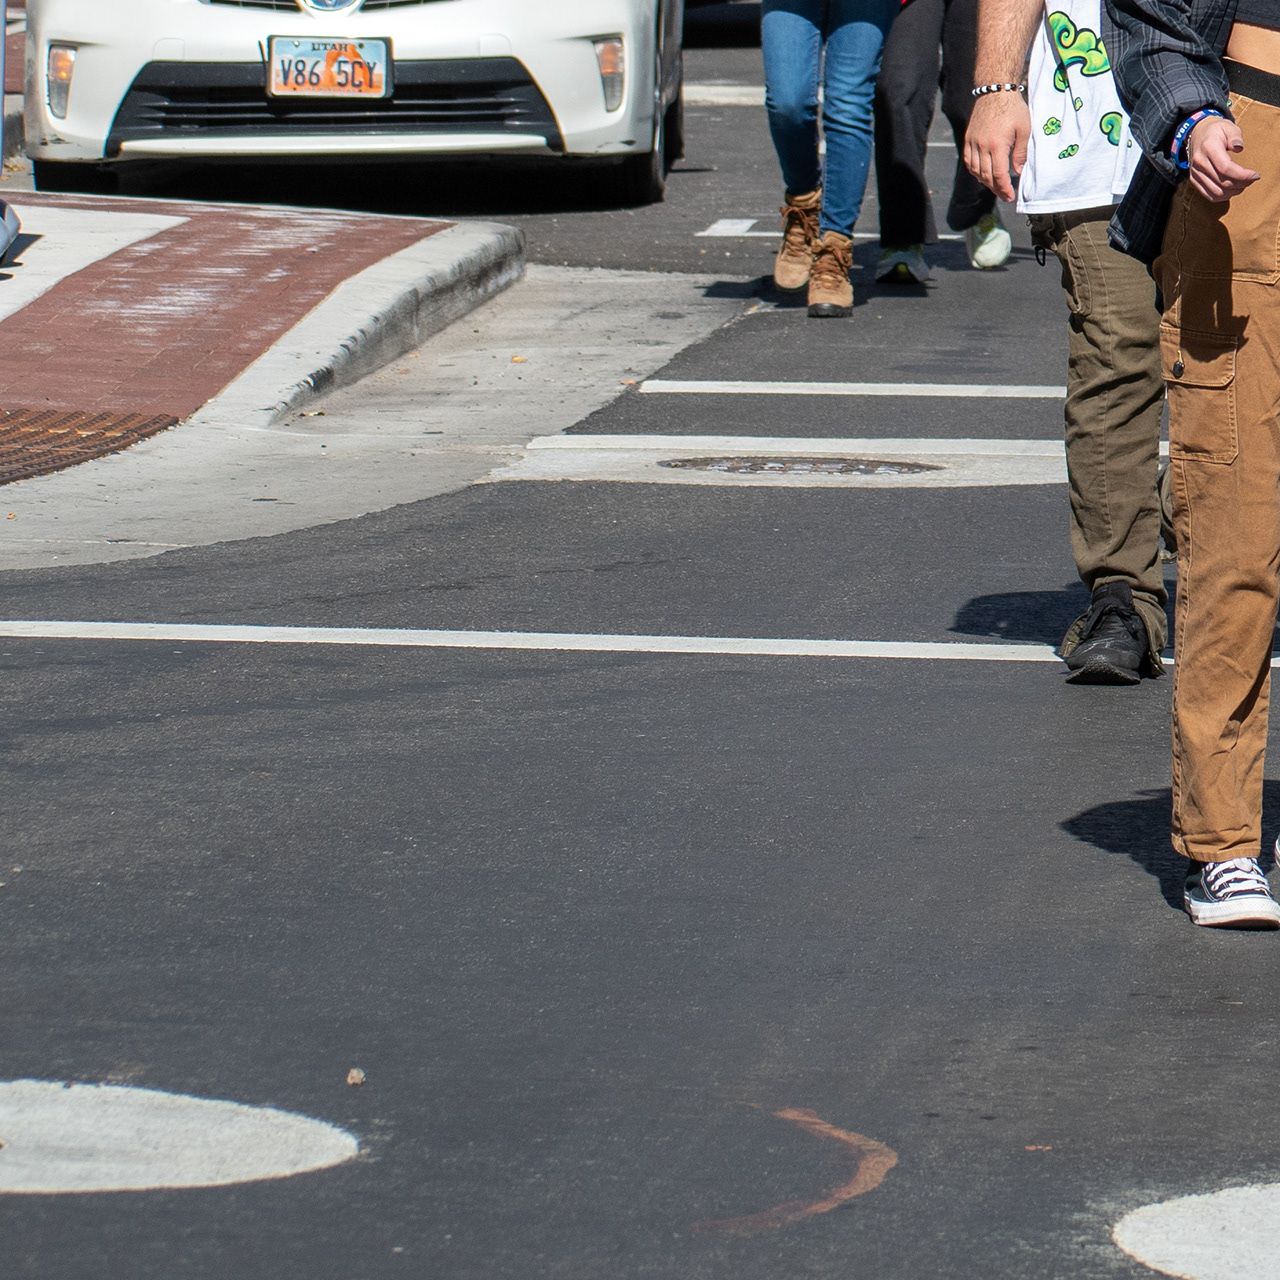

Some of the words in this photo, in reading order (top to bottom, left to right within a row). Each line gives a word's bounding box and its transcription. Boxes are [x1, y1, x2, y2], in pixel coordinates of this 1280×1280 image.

[311, 42, 348, 52] UTAH
[280, 59, 321, 87] V86
[336, 60, 377, 88] 5CY
